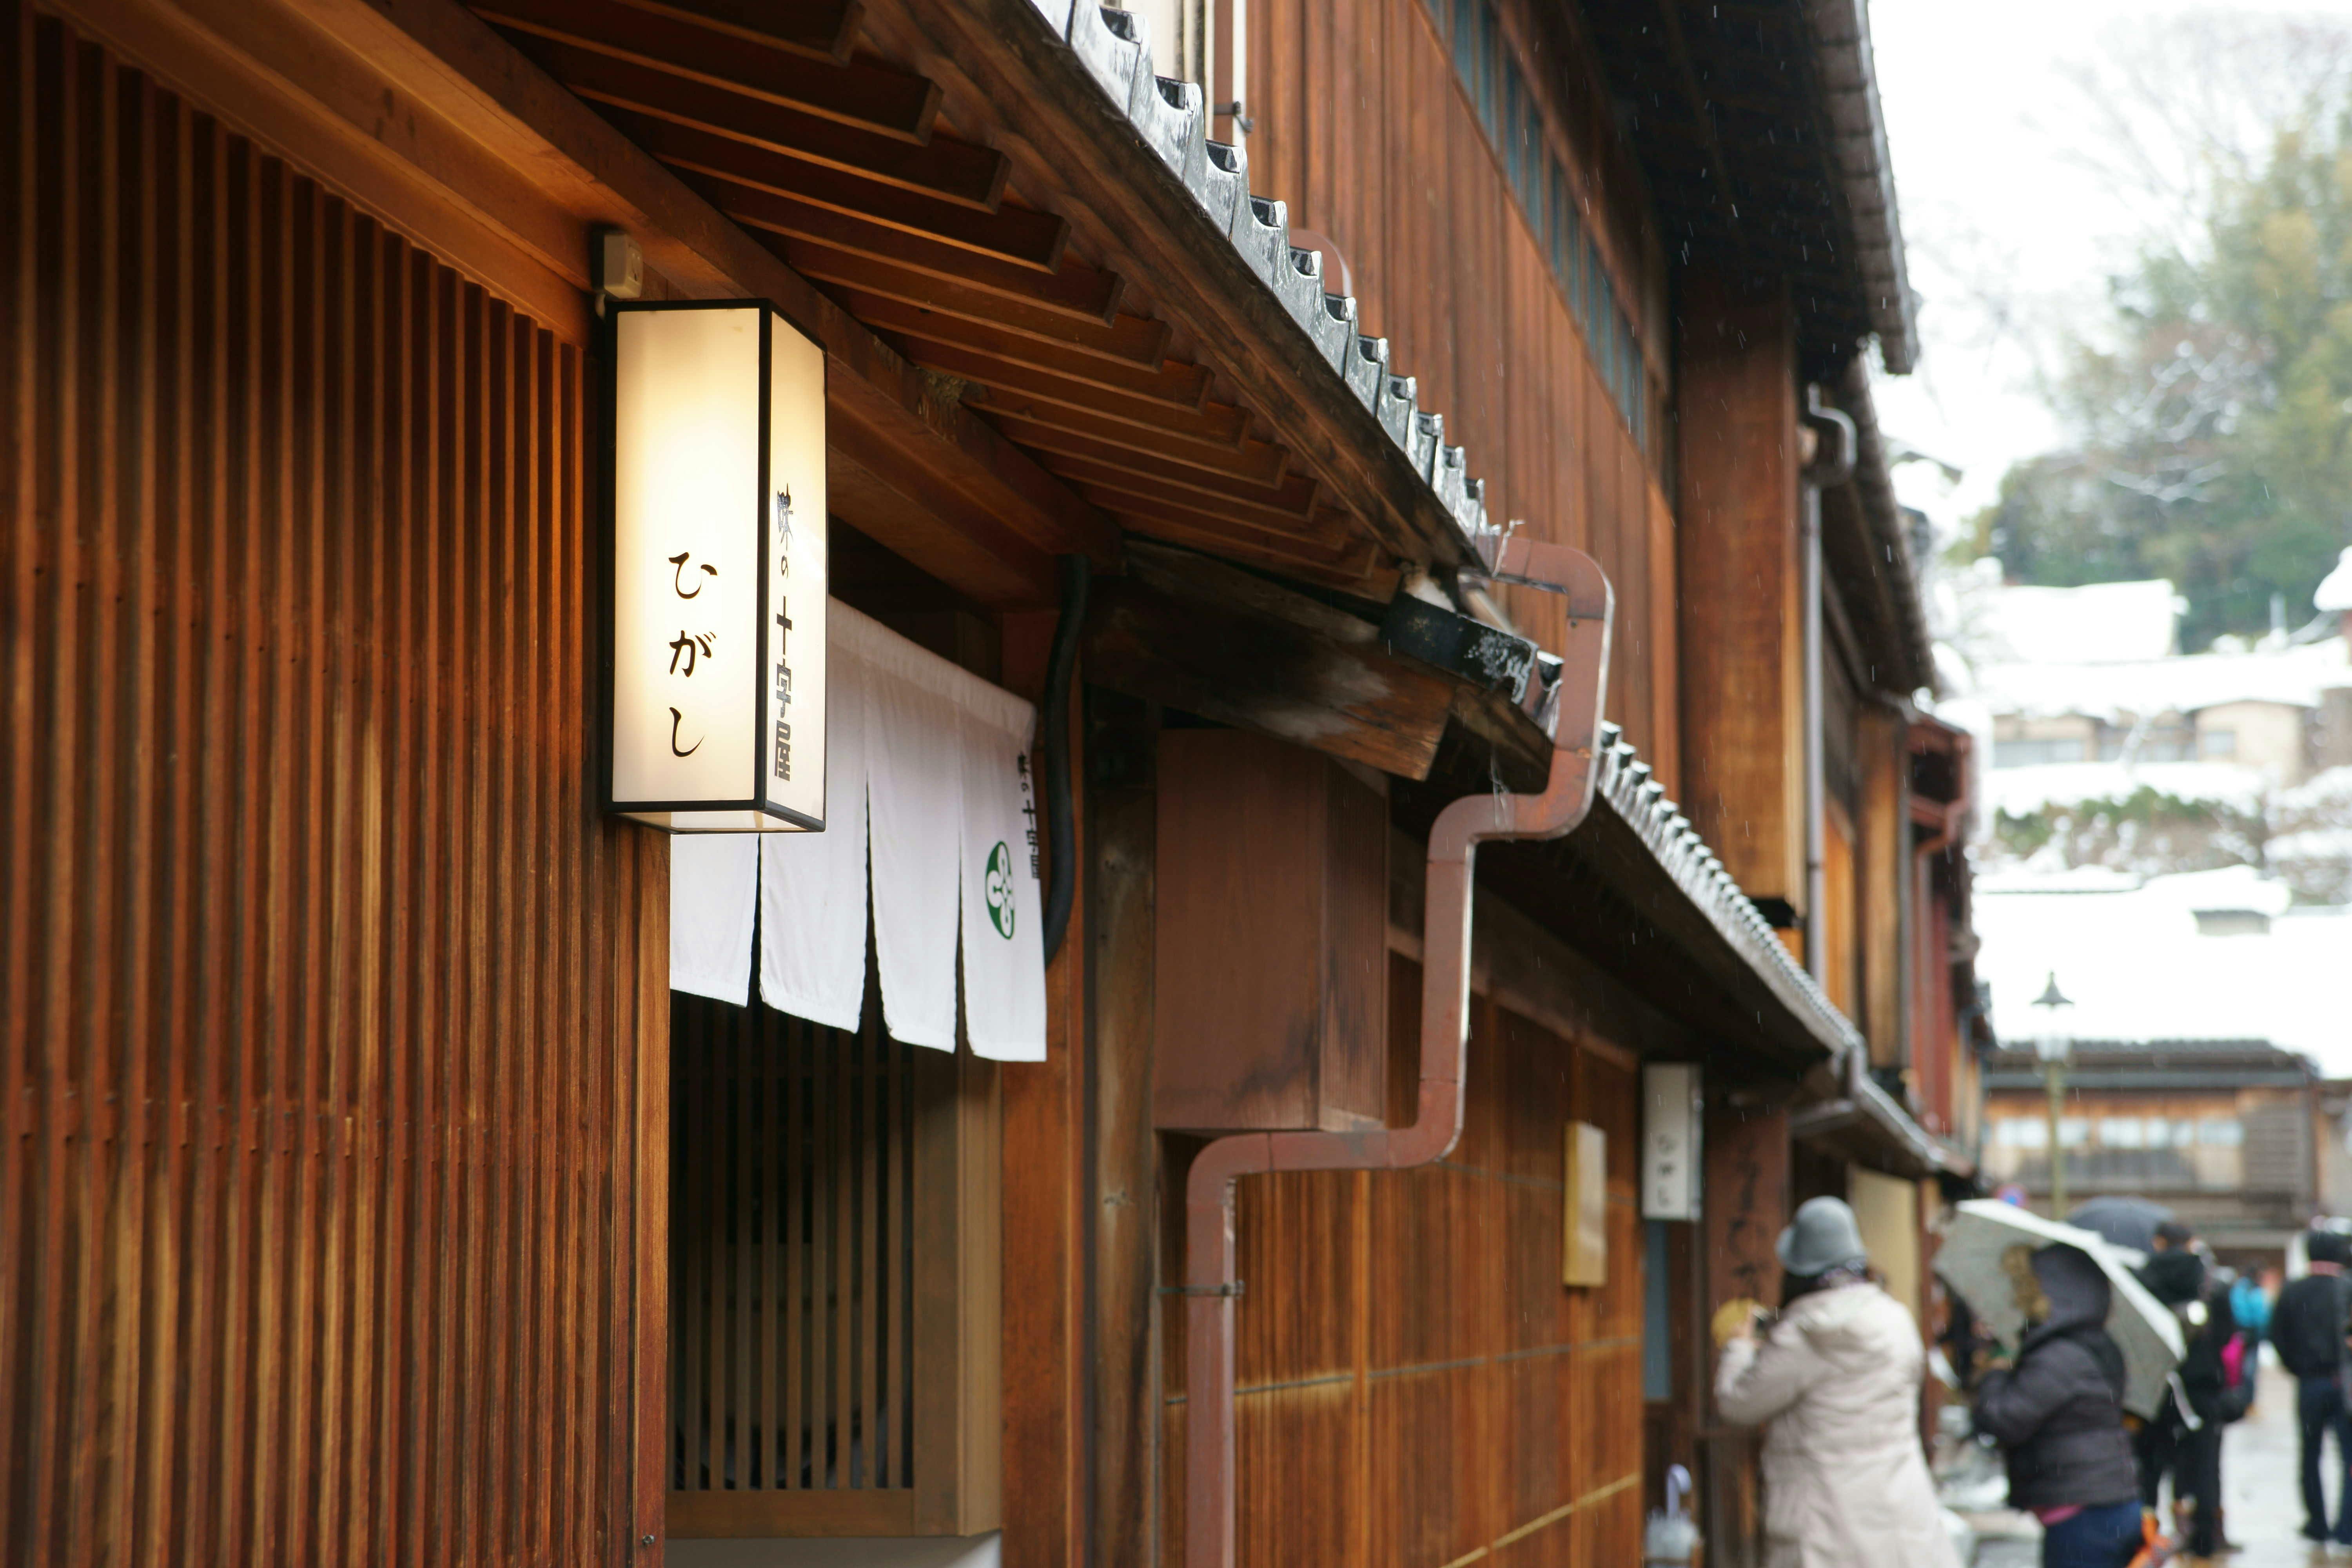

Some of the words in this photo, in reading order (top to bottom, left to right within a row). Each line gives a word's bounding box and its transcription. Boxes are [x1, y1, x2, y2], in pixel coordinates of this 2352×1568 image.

[668, 551, 718, 758] ひがし
[774, 483, 794, 782] 味の十字屋
